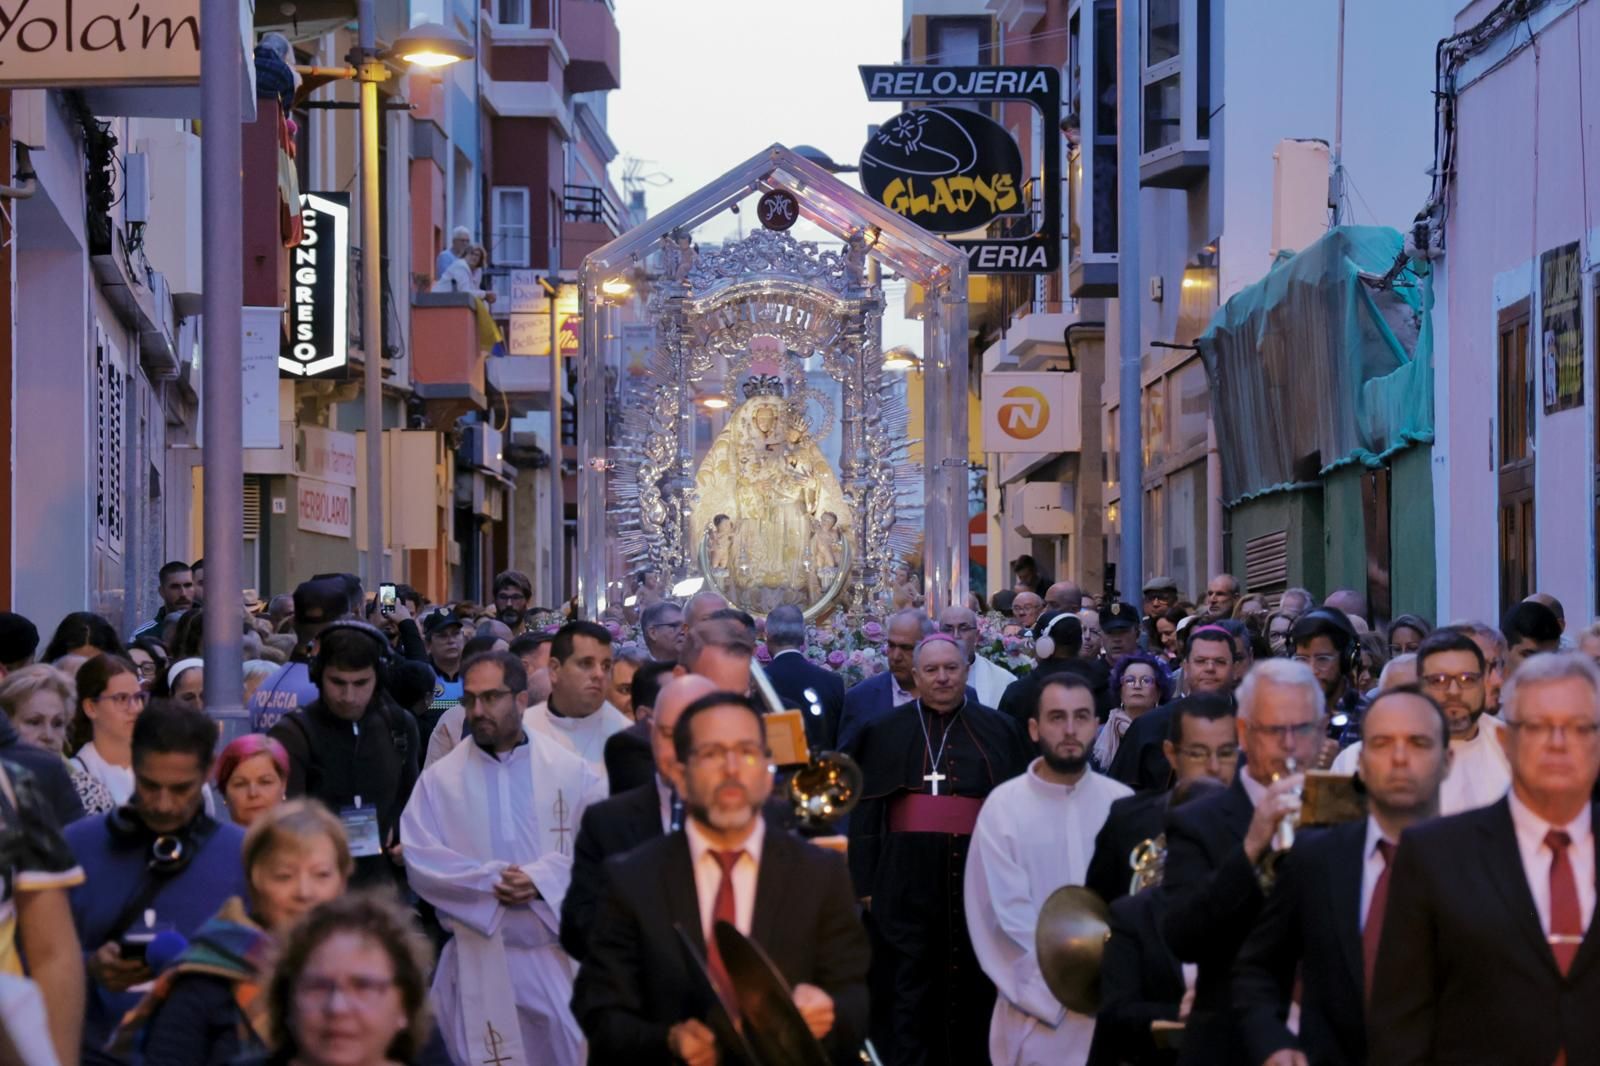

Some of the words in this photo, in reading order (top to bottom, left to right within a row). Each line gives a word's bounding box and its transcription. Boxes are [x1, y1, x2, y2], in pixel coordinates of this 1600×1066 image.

[871, 71, 1049, 95] RELOJERIA
[882, 172, 1018, 217] GLADYS
[960, 245, 1048, 268] YERIA
[293, 209, 319, 361] CONGRESO
[300, 488, 349, 526] HERBOLARIO
